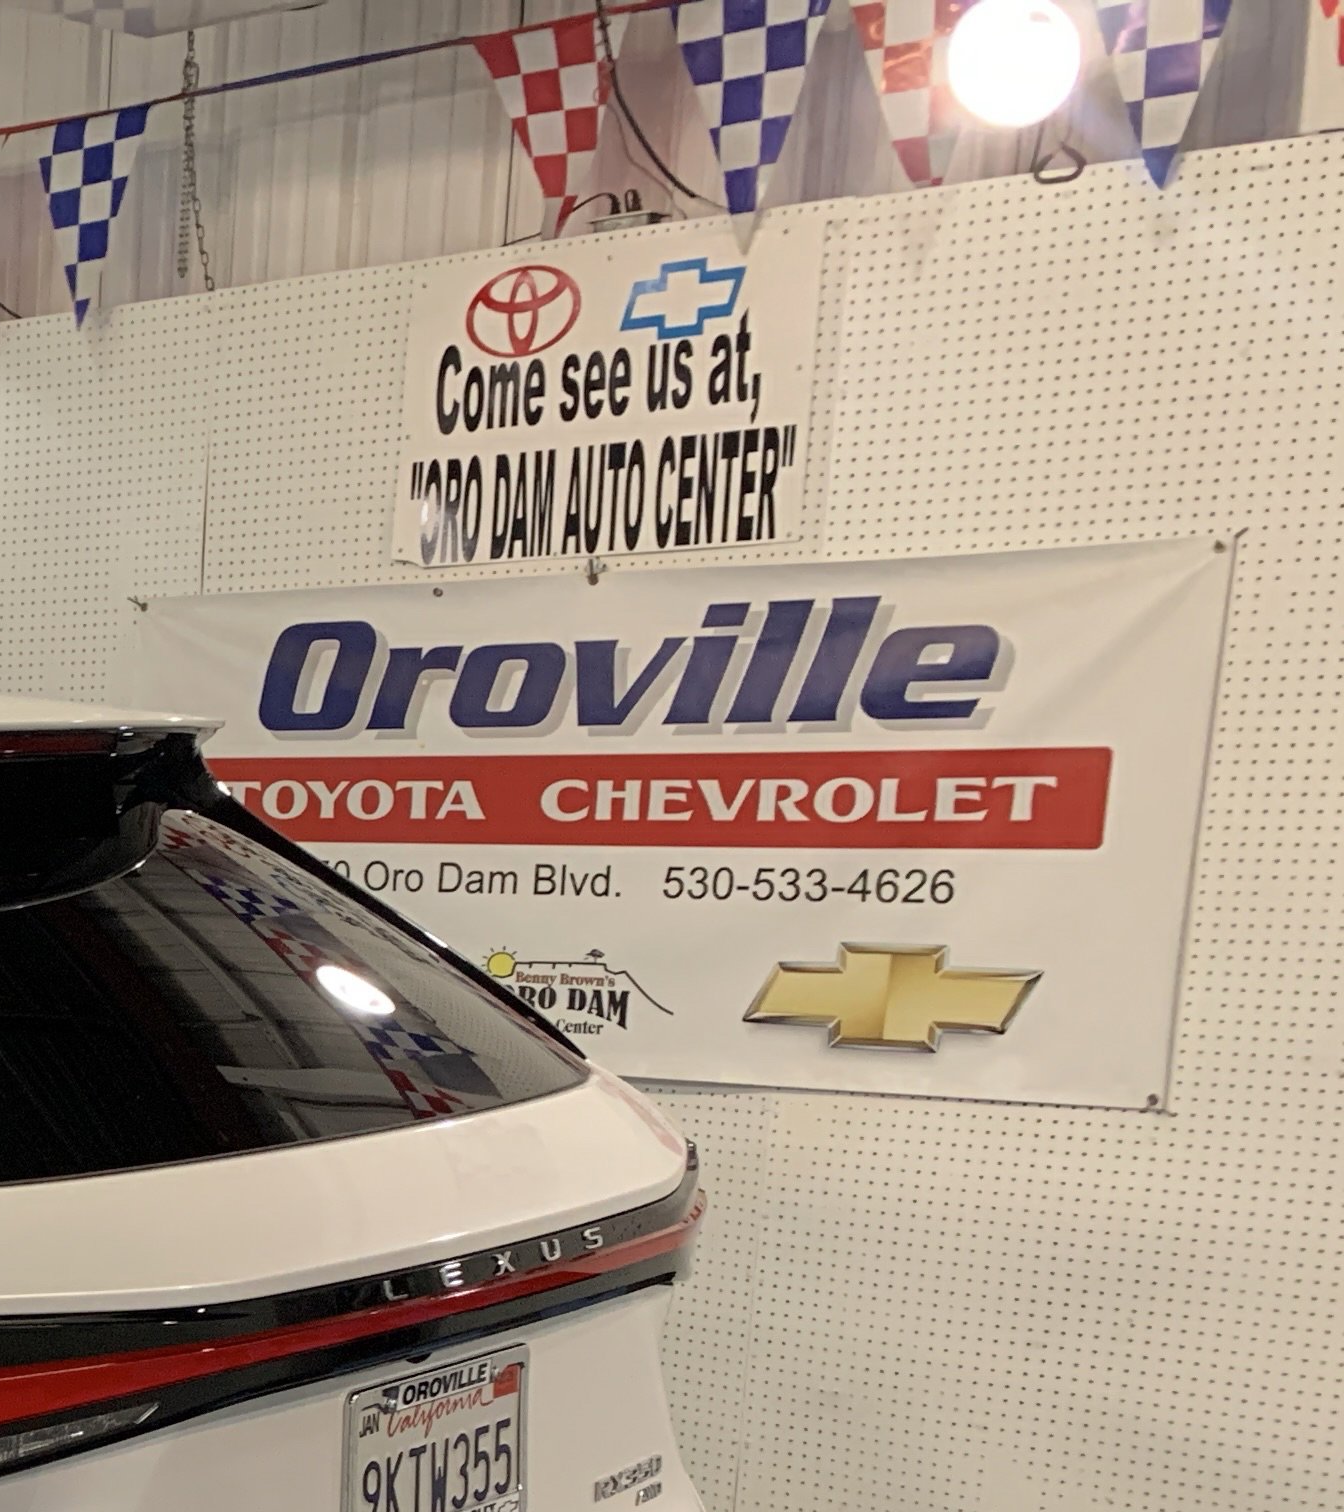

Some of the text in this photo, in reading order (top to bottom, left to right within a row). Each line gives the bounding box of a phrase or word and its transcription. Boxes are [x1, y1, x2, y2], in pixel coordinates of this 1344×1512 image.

[436, 308, 762, 435] Come see us at,
[489, 449, 557, 560] DAM
[561, 438, 646, 555] AUTO
[655, 424, 798, 550] CENTER"
[258, 595, 1004, 734] Oroville
[227, 775, 1058, 822] TOYOTA CHEVROLET
[363, 859, 424, 893] Oro
[437, 861, 518, 895] Dam
[533, 863, 623, 898] Blvd.
[662, 866, 956, 904] 530-533-4626
[514, 971, 616, 988] Benny Brown's
[506, 985, 631, 1030] RO DAM
[555, 1018, 605, 1035] Center
[382, 1226, 604, 1301] LEXUS
[402, 1362, 489, 1406] OROVILLE
[358, 1411, 381, 1439] JAN
[386, 1388, 494, 1439] California
